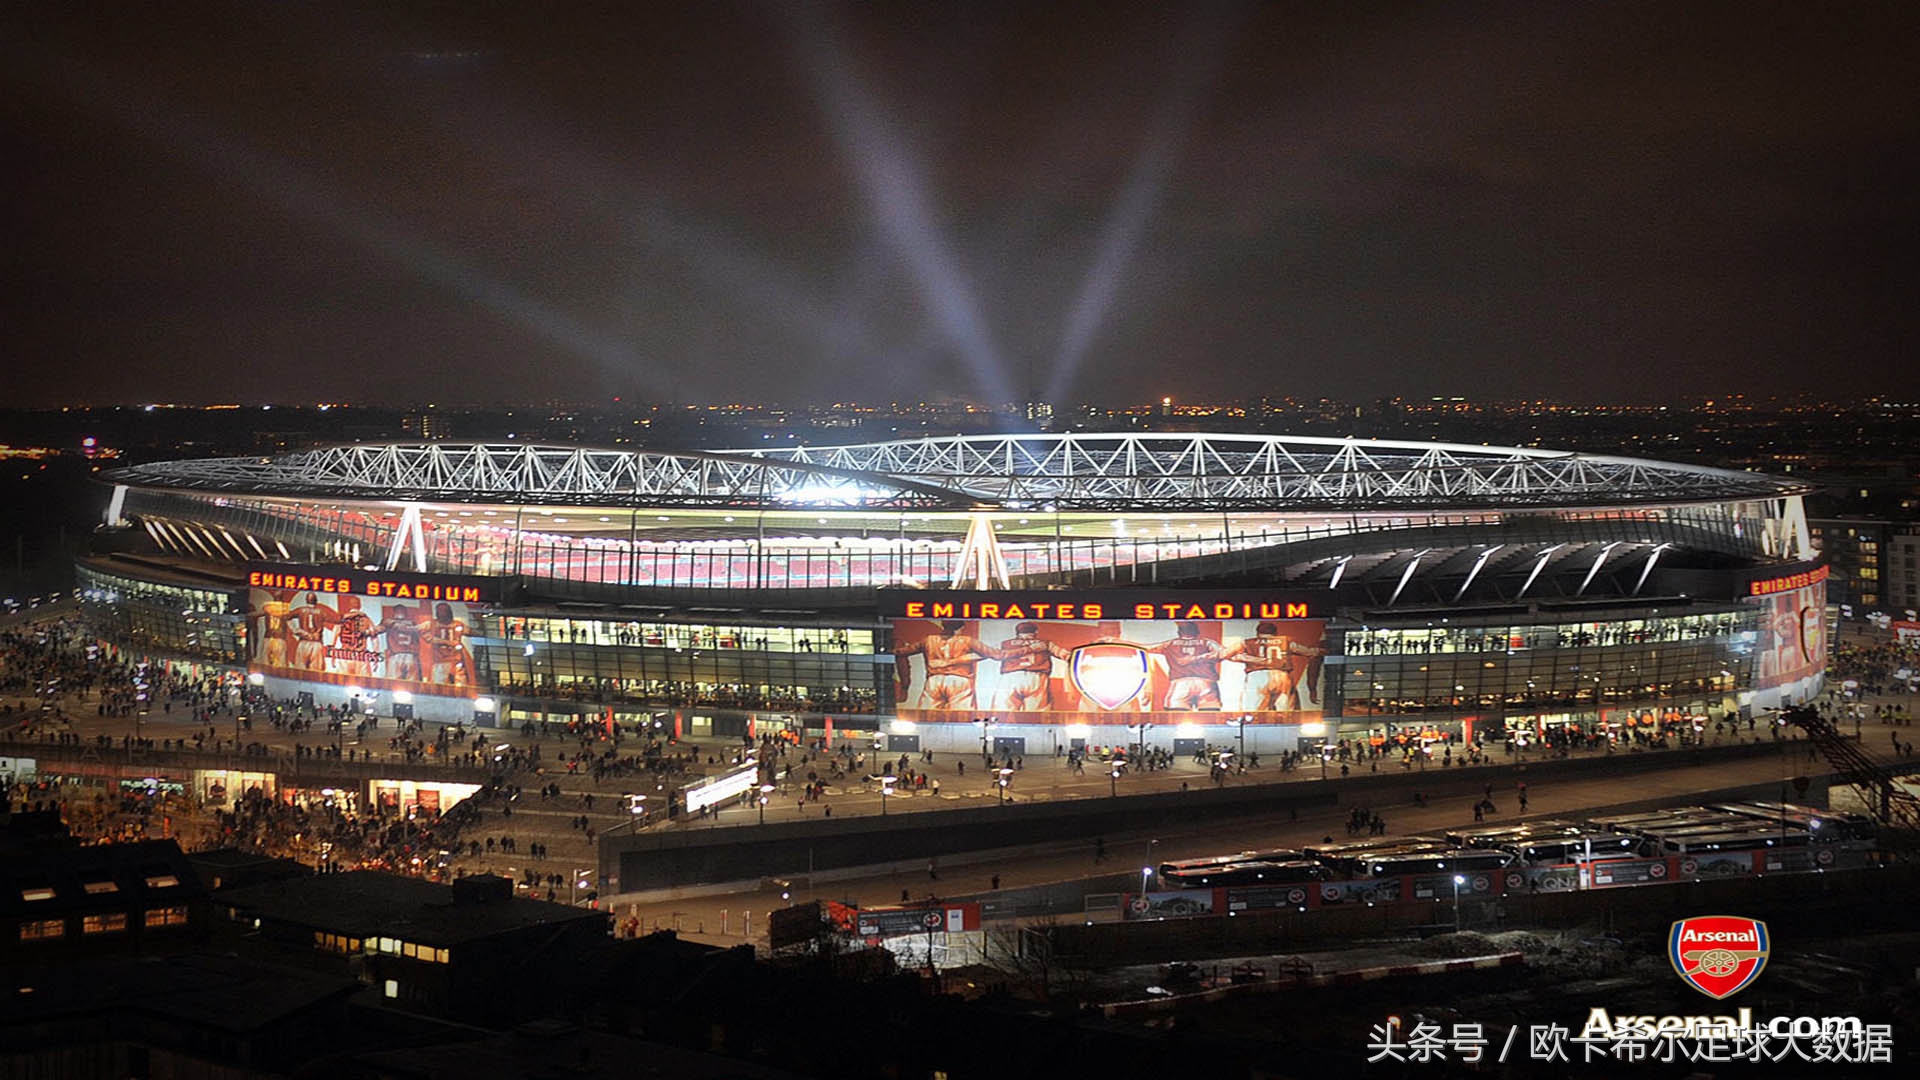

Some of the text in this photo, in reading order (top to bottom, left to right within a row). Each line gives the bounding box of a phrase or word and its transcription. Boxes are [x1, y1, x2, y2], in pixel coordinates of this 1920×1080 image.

[249, 572, 480, 603] EMIRATES STADIUM
[906, 602, 1308, 619] EMIRATES STADIUM
